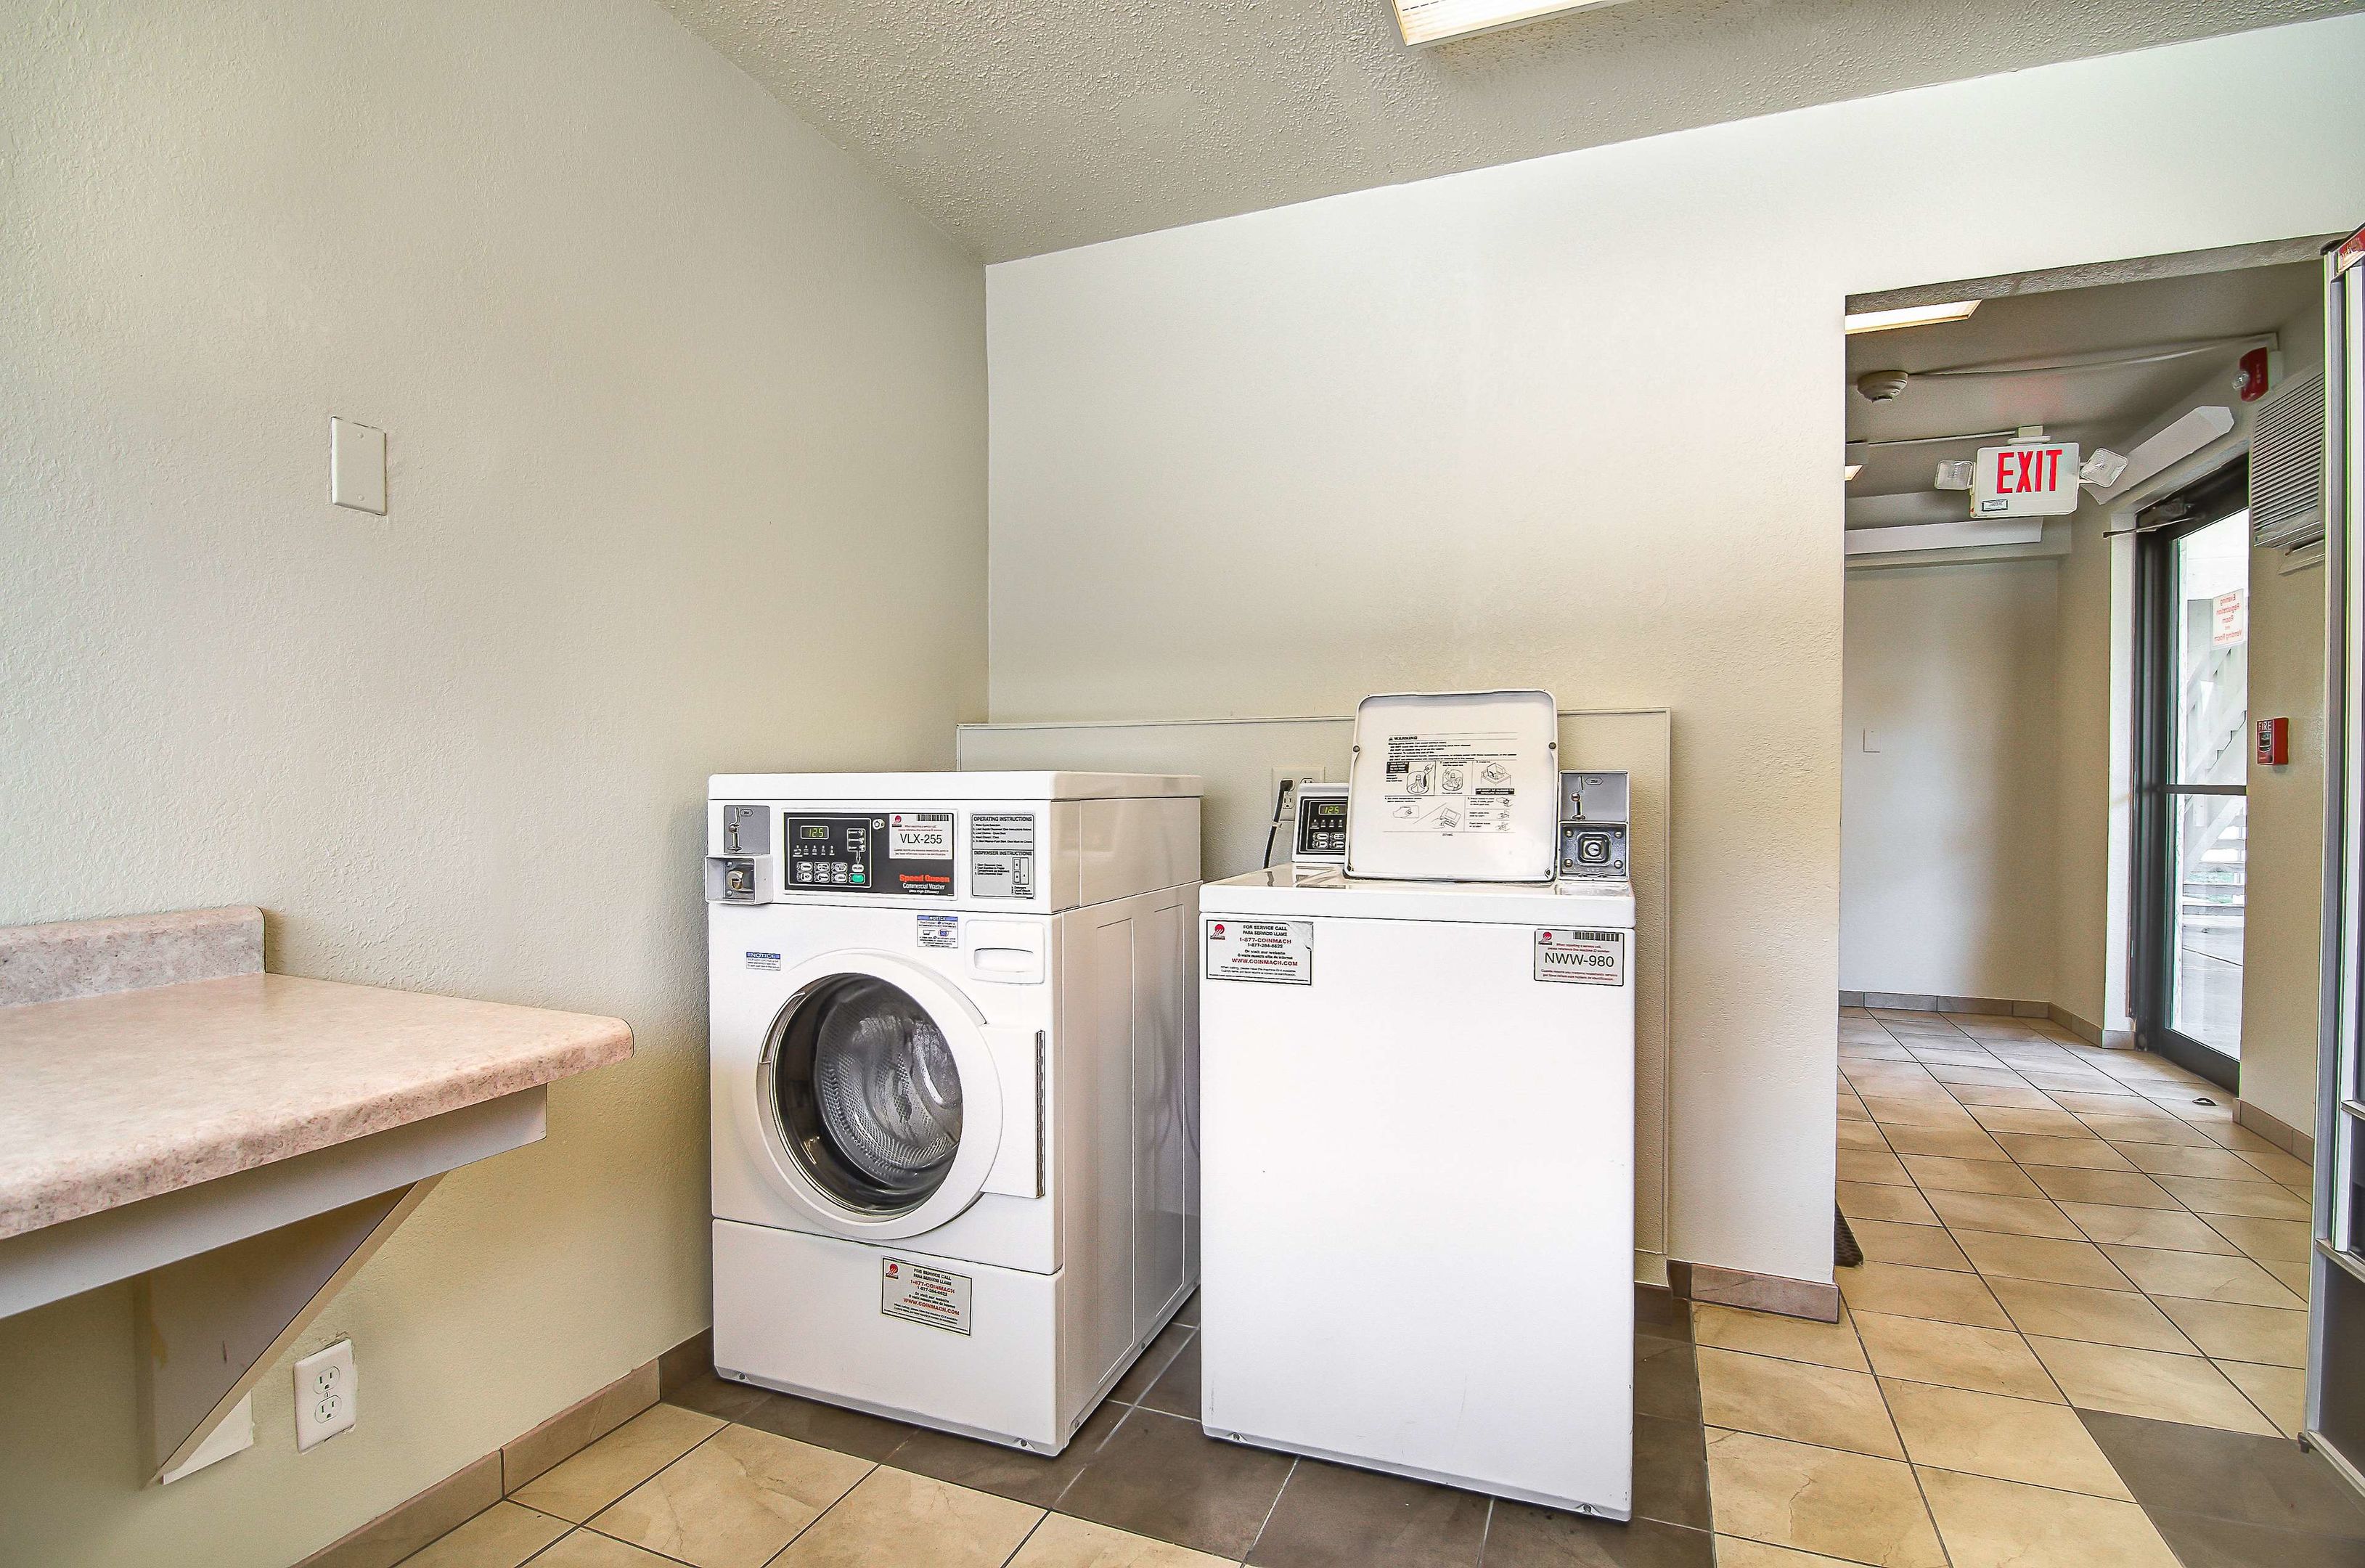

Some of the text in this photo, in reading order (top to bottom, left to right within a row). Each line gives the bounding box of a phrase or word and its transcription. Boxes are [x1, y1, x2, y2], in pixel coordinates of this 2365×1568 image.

[1996, 449, 2063, 494] EXIT
[2258, 721, 2272, 731] FIRE
[809, 828, 824, 837] 125
[900, 833, 942, 844] VLX-255
[899, 874, 950, 883] Speed Queen
[1231, 957, 1298, 966] WWW.COINMACH.COM
[1545, 952, 1614, 968] NWW-980
[910, 1279, 955, 1294] 1-877-COINMACH
[903, 1297, 960, 1315] WWW.COINMACH.COM
